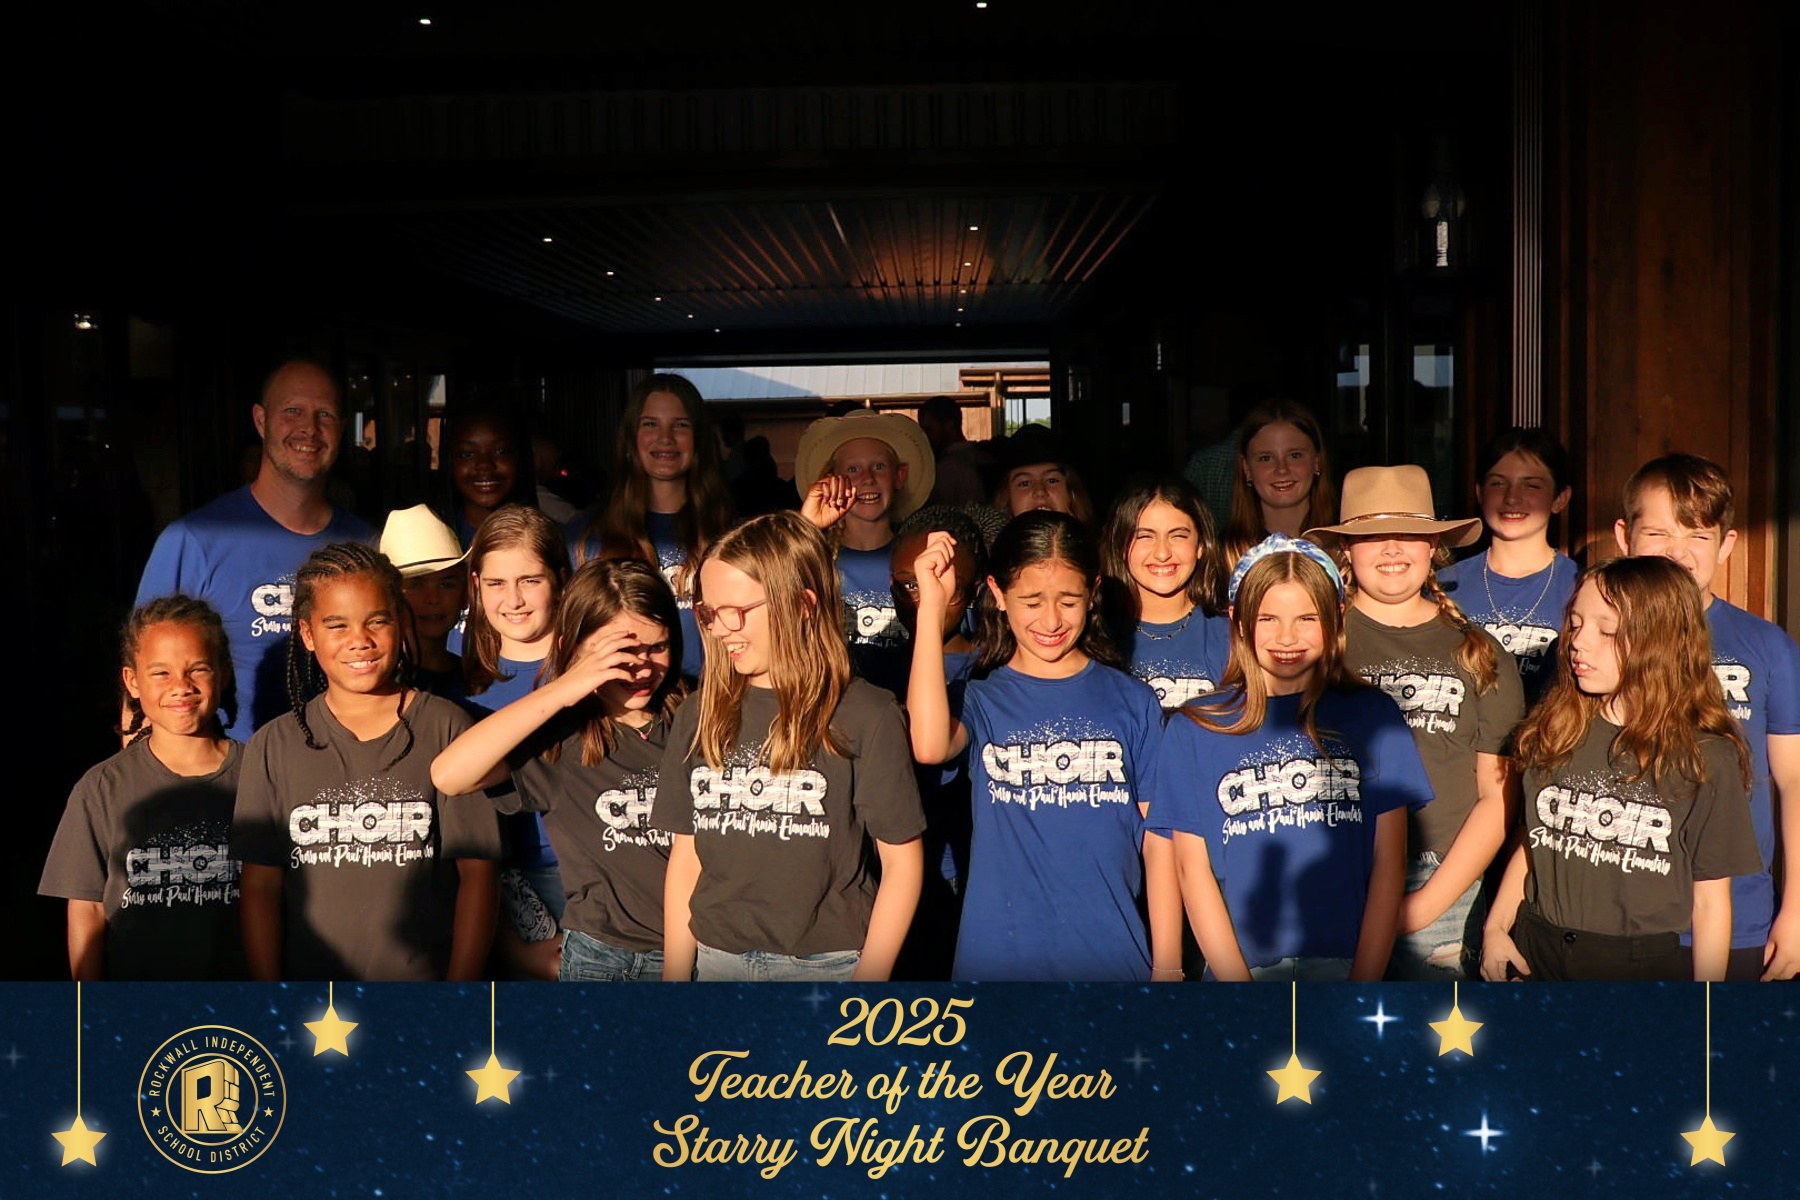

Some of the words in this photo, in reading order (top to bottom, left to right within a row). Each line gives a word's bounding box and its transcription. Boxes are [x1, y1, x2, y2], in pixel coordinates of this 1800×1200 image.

[1484, 622, 1559, 657] OIR
[982, 740, 1127, 787] CHOIR
[689, 765, 828, 817] CHOIR
[1028, 785, 1056, 811] Paul
[1088, 783, 1130, 808] Elementary
[1217, 757, 1361, 817] CHOIR
[289, 800, 433, 847] CHOIR
[721, 810, 747, 836] Paul
[779, 814, 830, 841] Elementary
[1267, 807, 1295, 834] Paul
[1535, 784, 1672, 854] CHOIR
[333, 843, 360, 868] Paul
[1564, 835, 1589, 860] Paul
[1621, 847, 1671, 876] Elementary
[165, 884, 191, 908] Paul
